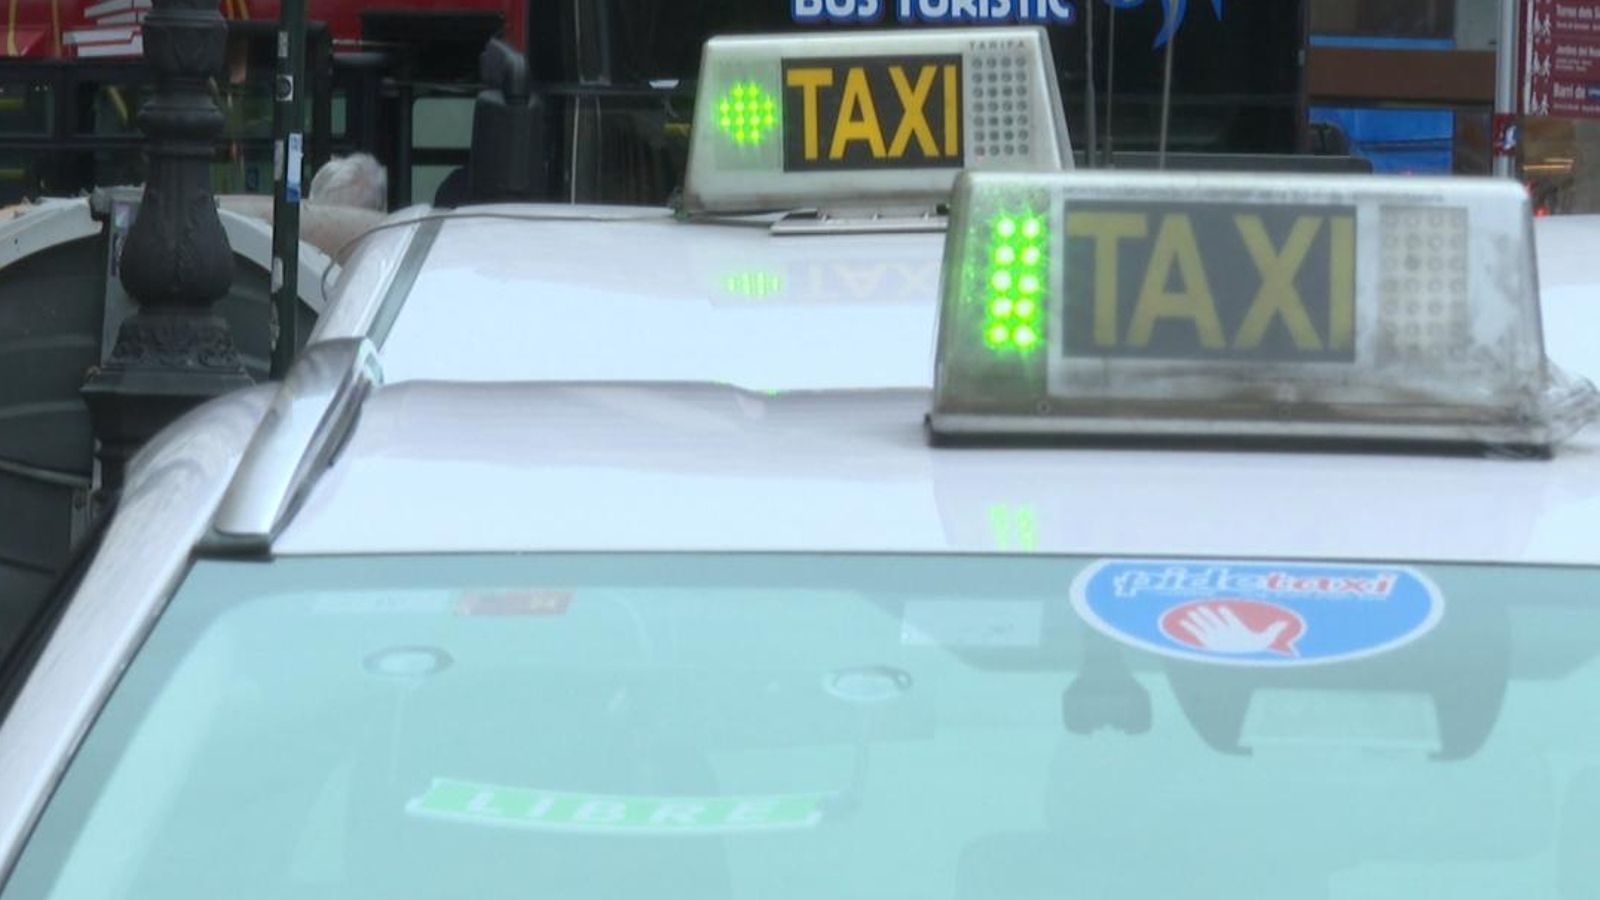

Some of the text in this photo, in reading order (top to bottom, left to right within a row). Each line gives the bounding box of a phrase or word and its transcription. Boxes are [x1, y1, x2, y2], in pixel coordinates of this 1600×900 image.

[786, 65, 958, 160] TAXI
[1066, 211, 1354, 351] TAXI
[466, 791, 781, 825] LIBRE
